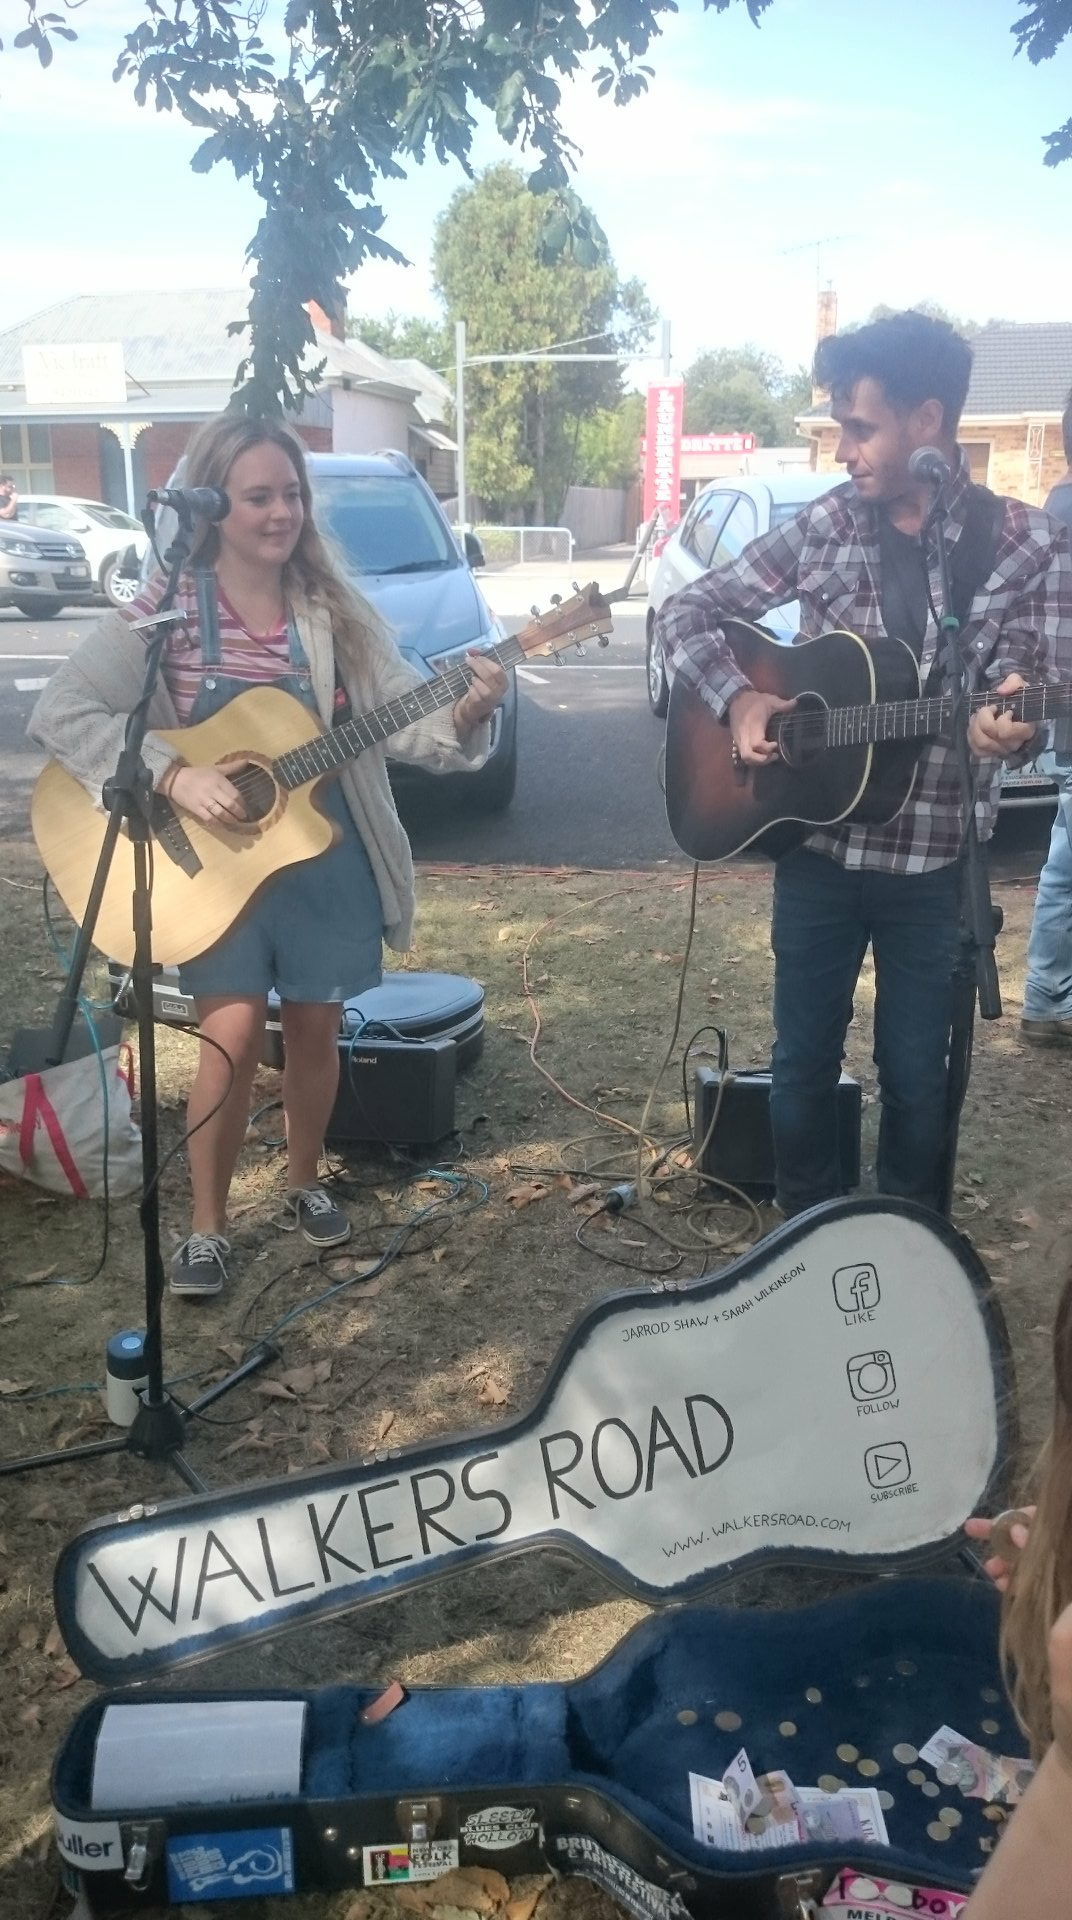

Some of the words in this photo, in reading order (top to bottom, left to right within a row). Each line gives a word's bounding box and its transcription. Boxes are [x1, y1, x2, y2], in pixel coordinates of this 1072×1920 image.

[655, 389, 675, 501] LAUNDRETTE
[621, 1320, 670, 1343] JARROD
[673, 1315, 709, 1332] SHAW
[721, 1299, 754, 1322] SARAH
[755, 1262, 807, 1302] WILKINSON
[844, 1309, 877, 1326] LIKE
[856, 1399, 900, 1417] FOLLOW
[870, 1482, 919, 1504] SUBSCRIBE
[87, 1451, 512, 1637] WALKERS
[539, 1393, 735, 1520] ROAD
[737, 1754, 747, 1773] 5
[467, 1808, 535, 1826] SLEEPY
[460, 1824, 500, 1833] BLUES
[464, 1828, 535, 1845] HOLLOW
[412, 1851, 452, 1862] FOLK
